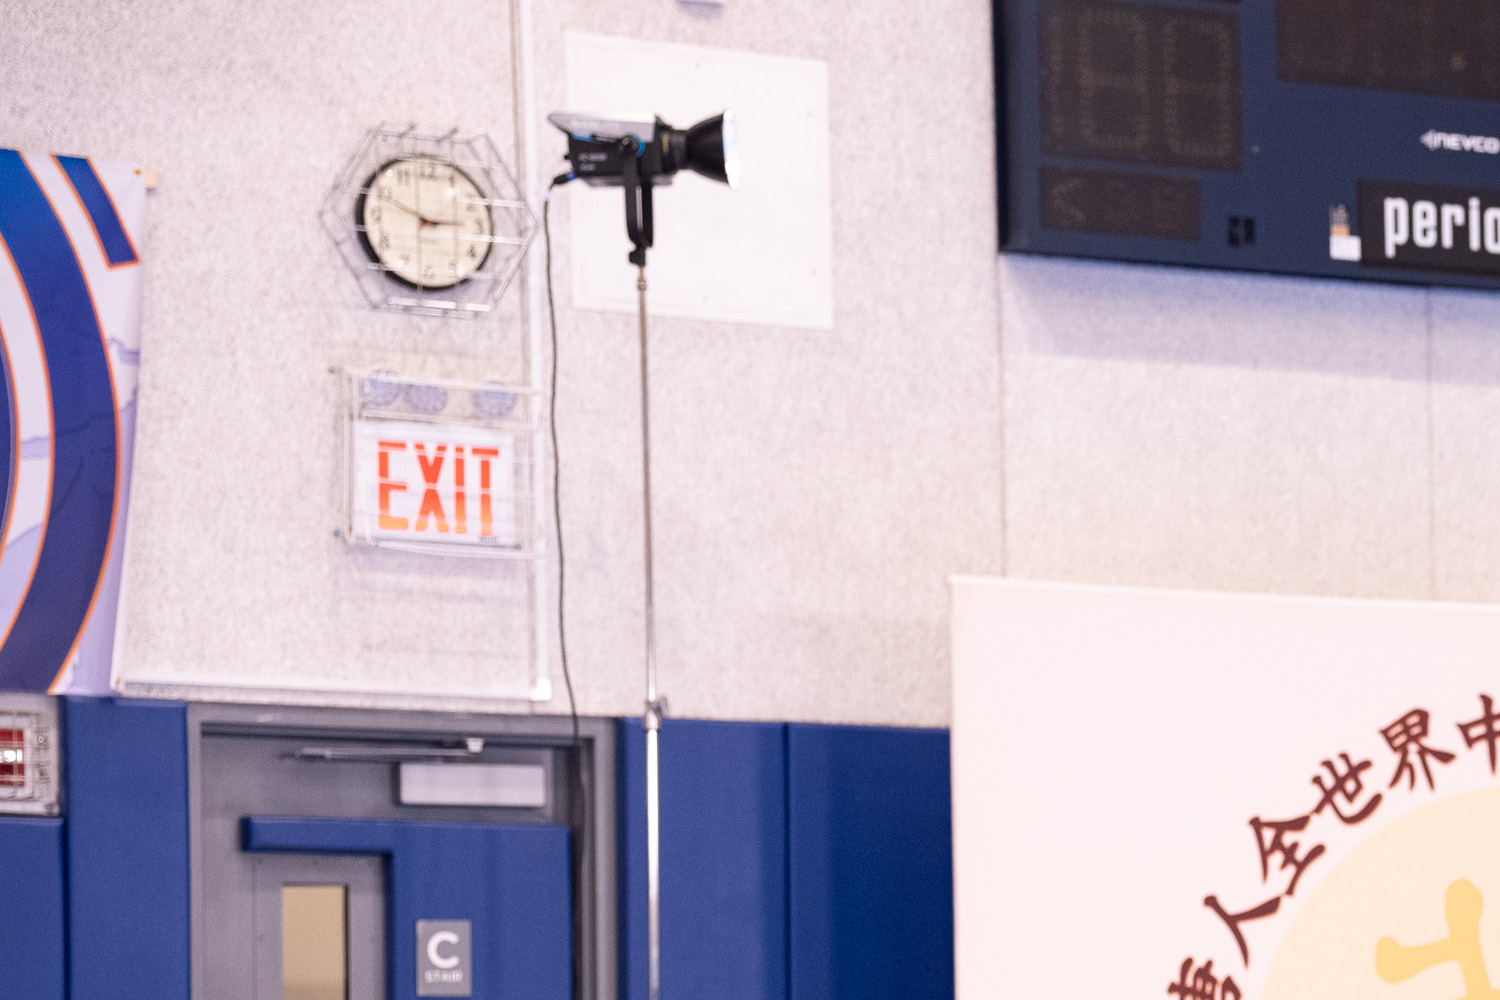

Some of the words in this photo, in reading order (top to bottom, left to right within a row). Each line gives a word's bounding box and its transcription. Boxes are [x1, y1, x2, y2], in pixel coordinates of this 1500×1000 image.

[378, 440, 500, 537] EXIT
[427, 931, 460, 968] C
[424, 969, 463, 983] STAIR
